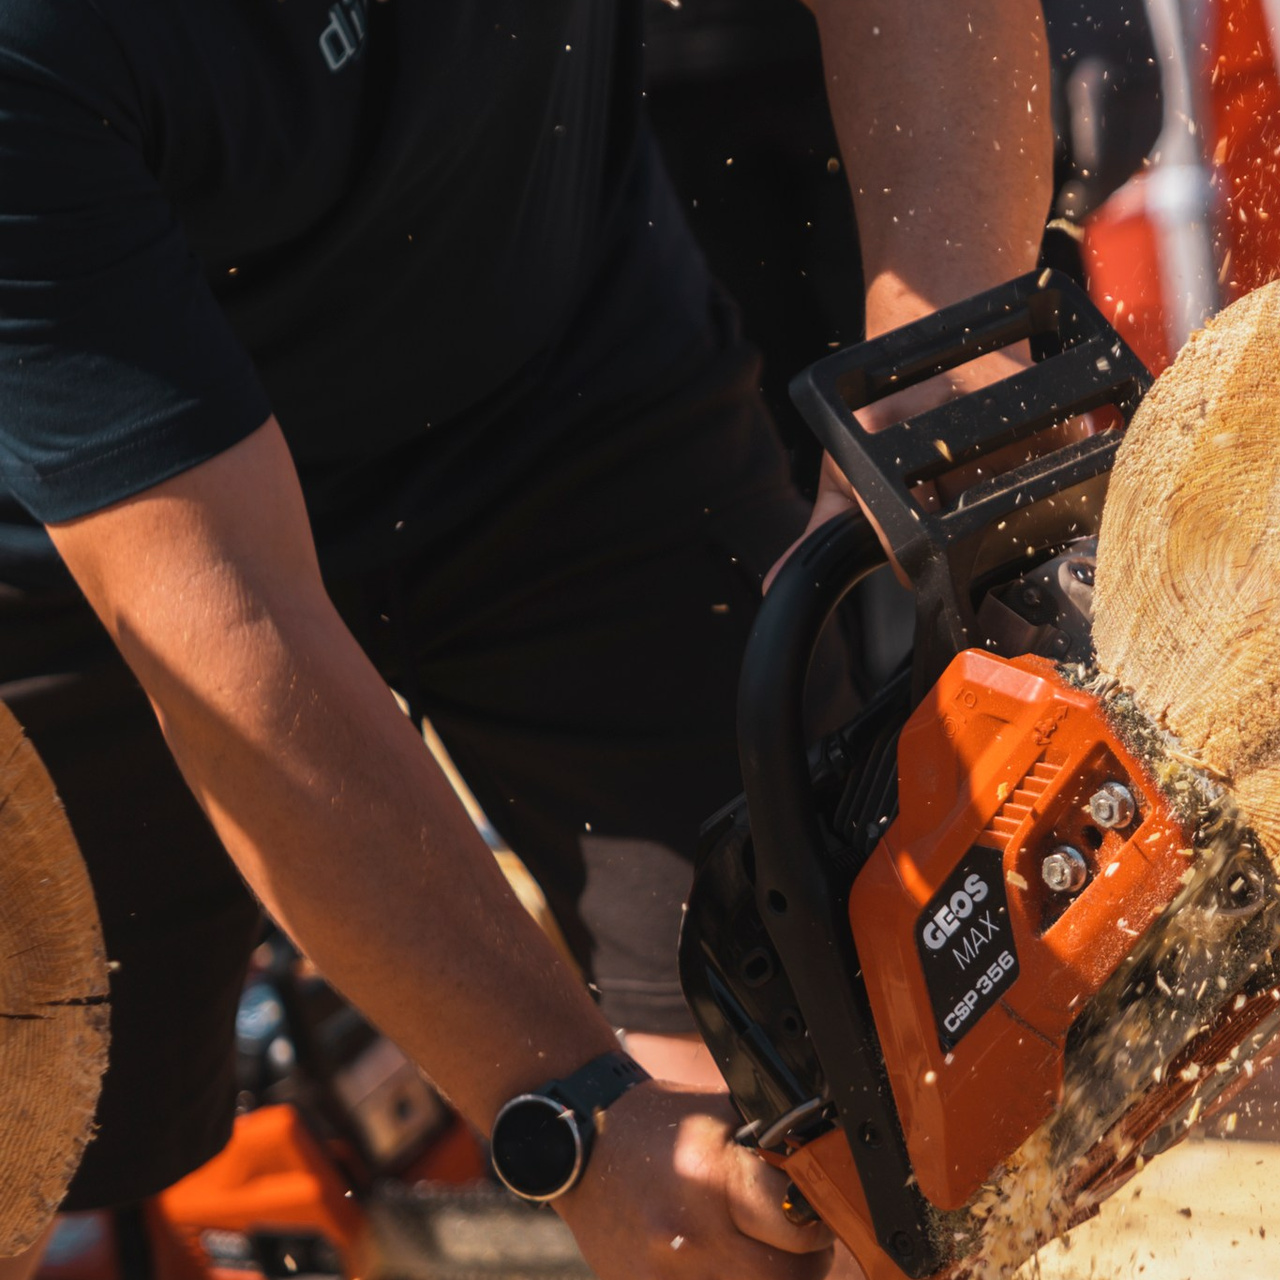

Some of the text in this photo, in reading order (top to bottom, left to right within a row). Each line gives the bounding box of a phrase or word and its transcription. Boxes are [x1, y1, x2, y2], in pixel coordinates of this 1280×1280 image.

[922, 873, 989, 950] GEOS
[952, 910, 1000, 971] MAX
[943, 949, 1015, 1033] CSP 356
